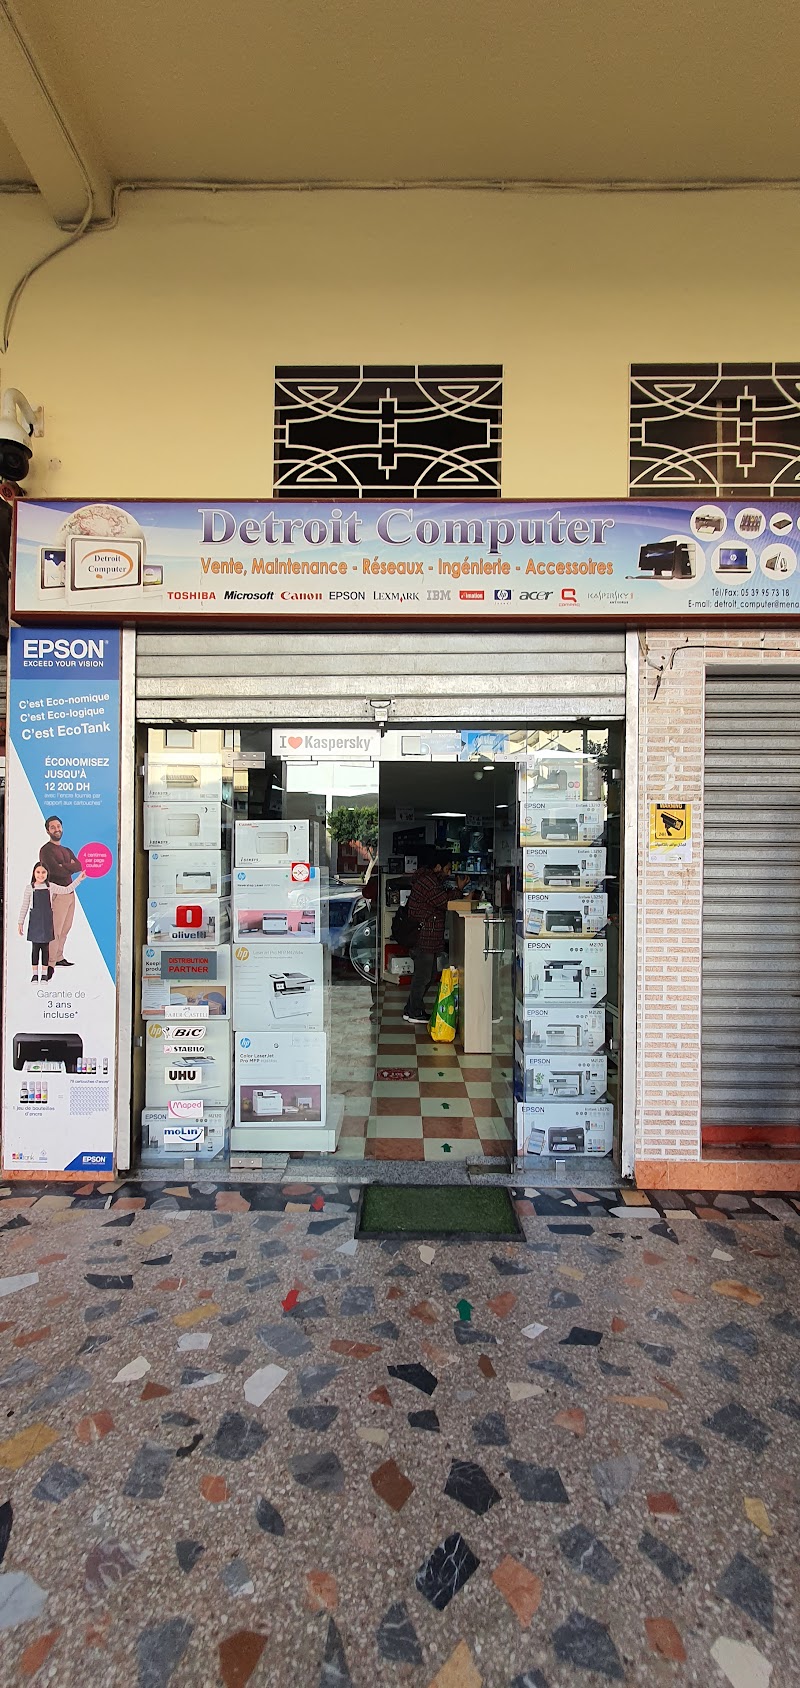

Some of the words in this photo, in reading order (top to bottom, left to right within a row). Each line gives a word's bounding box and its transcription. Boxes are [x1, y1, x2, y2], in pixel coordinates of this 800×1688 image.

[198, 508, 363, 546] Detroit
[376, 508, 615, 556] Computer
[94, 554, 121, 562] Detroit
[88, 565, 127, 575] Computer
[201, 557, 247, 576] Vente,
[251, 557, 348, 575] Maintenance
[362, 556, 424, 575] Réseaux
[438, 556, 511, 579] Ingénierie
[525, 558, 613, 575] Accessoires
[167, 591, 216, 600] TOSHIBA
[223, 590, 275, 600] Microsoft
[280, 591, 323, 600] Canon
[329, 591, 366, 600] EPSON
[373, 591, 420, 603] LEXMARK
[427, 590, 451, 600] IBM
[519, 590, 553, 600] acer
[712, 588, 739, 597] Tél/Fax:
[741, 589, 748, 597] 05
[751, 589, 759, 597] 39
[761, 589, 770, 597] 95
[771, 589, 780, 597] 73
[781, 589, 790, 597] 18
[688, 600, 712, 608] E-mail:
[23, 639, 104, 659] EPSON
[19, 699, 44, 709] C'est
[46, 693, 110, 707] Eco-nomique
[20, 713, 45, 722] C'est
[47, 707, 105, 720] Eco-logique
[21, 727, 54, 740] C'est
[57, 721, 111, 737] EcoTank
[279, 736, 287, 749] I
[305, 735, 371, 751] Kaspersky
[44, 755, 110, 767] ÉCONOMISEZ
[44, 768, 87, 779] JUSQU'À
[45, 782, 55, 791] 12
[57, 782, 74, 791] 200
[76, 782, 90, 791] DH
[172, 931, 206, 939] olivetti
[235, 947, 249, 961] hp
[36, 990, 73, 998] Garantie
[74, 990, 86, 998] de
[47, 1000, 53, 1008] 3
[168, 1070, 196, 1081] UHU
